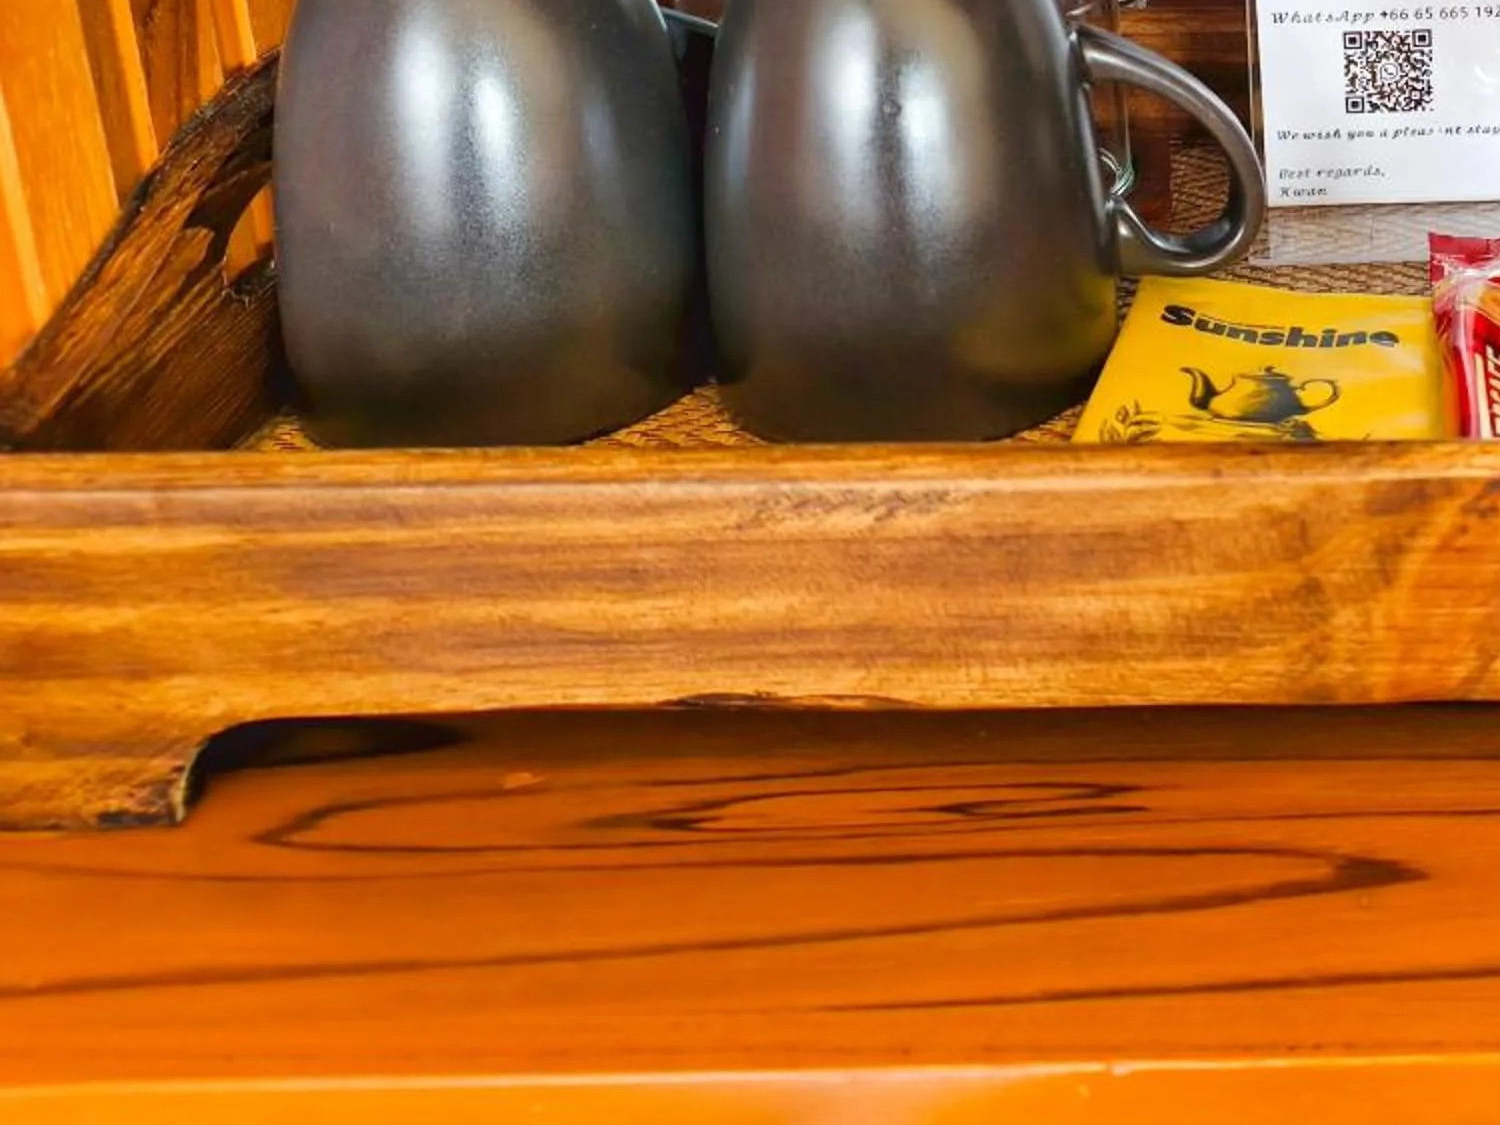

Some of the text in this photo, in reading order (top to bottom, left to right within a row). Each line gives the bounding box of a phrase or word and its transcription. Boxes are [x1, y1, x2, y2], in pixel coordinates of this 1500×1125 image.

[1380, 5, 1410, 20] +66
[1415, 5, 1434, 20] 65
[1440, 5, 1470, 20] 665
[1277, 129, 1300, 141] We
[1303, 128, 1342, 140] wish
[1347, 129, 1375, 141] you
[1160, 302, 1400, 349] Sunshine
